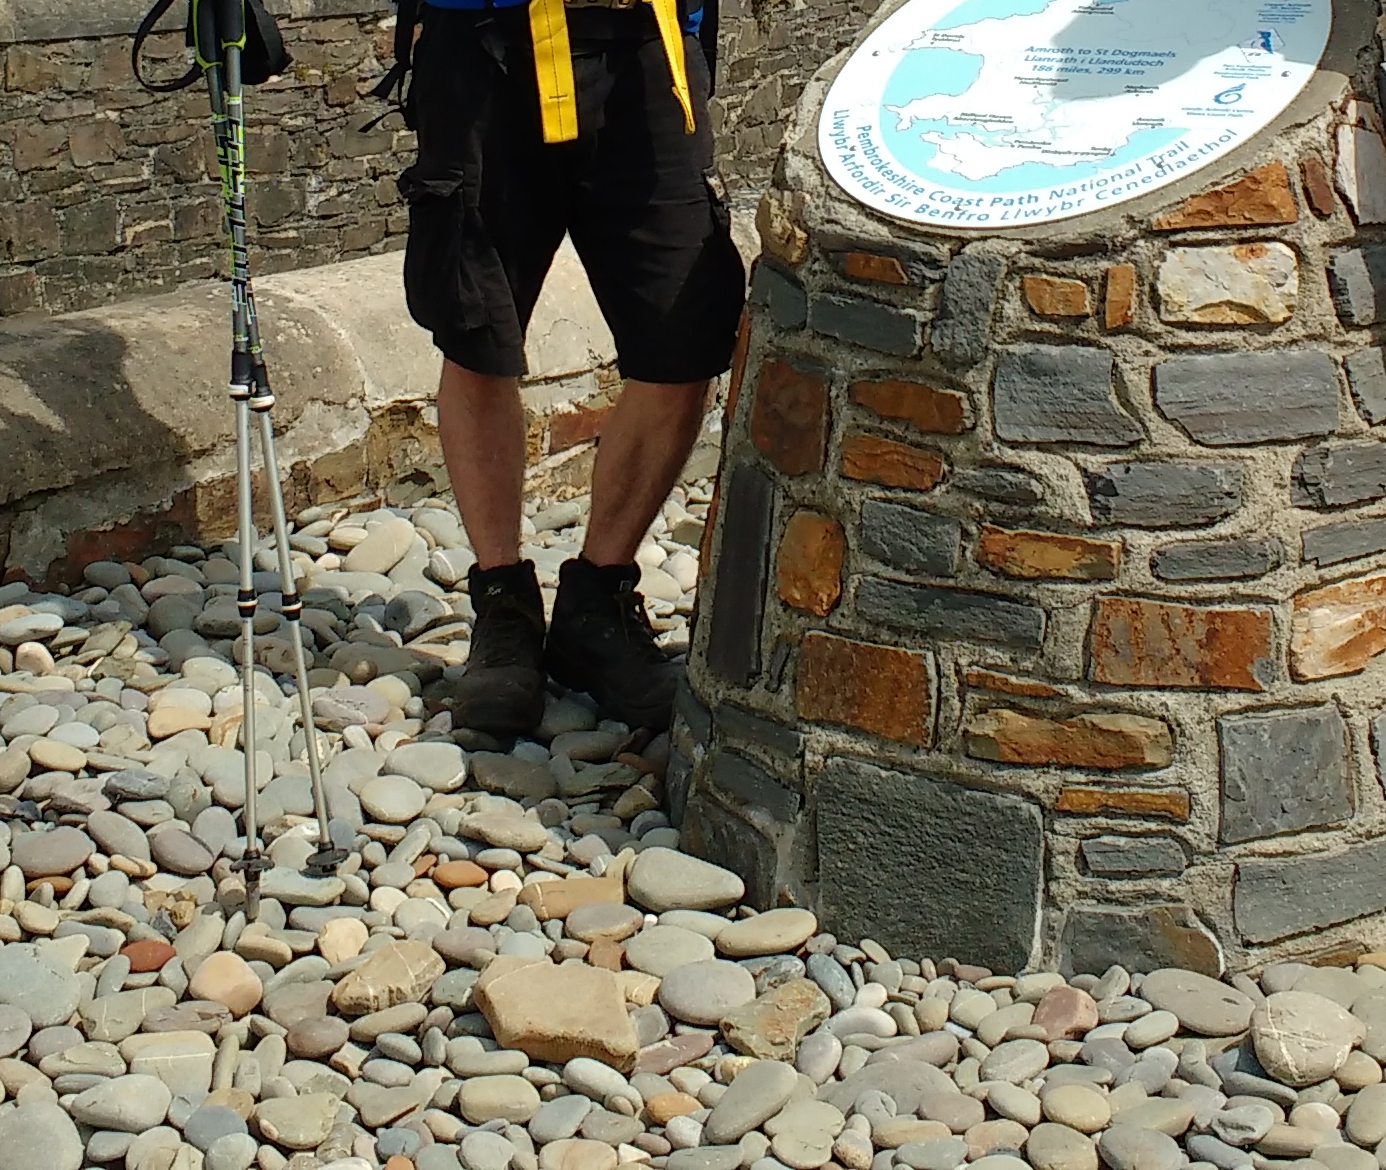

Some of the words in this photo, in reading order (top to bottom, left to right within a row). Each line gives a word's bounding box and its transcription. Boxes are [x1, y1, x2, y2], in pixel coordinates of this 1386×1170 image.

[1024, 54, 1077, 64] Llanrath
[1088, 57, 1165, 67] Llandudoch
[1025, 46, 1074, 55] Amroth
[1077, 48, 1091, 56] to
[1094, 48, 1109, 56] St
[1111, 49, 1177, 58] Dogmaels
[1056, 66, 1092, 74] miles,
[1124, 68, 1145, 76] km
[828, 108, 851, 151] Llwybr
[838, 153, 886, 197] Arfordir
[856, 124, 926, 196] Pembrokeshire
[928, 190, 987, 207] Coast
[989, 193, 1039, 207] Path
[1048, 162, 1143, 200] National
[1146, 140, 1190, 165] Trail
[1095, 128, 1238, 201] Cenedlaethol
[884, 192, 912, 209] Sir
[1000, 197, 1085, 221] Llwybr
[914, 203, 991, 222] Benfro
